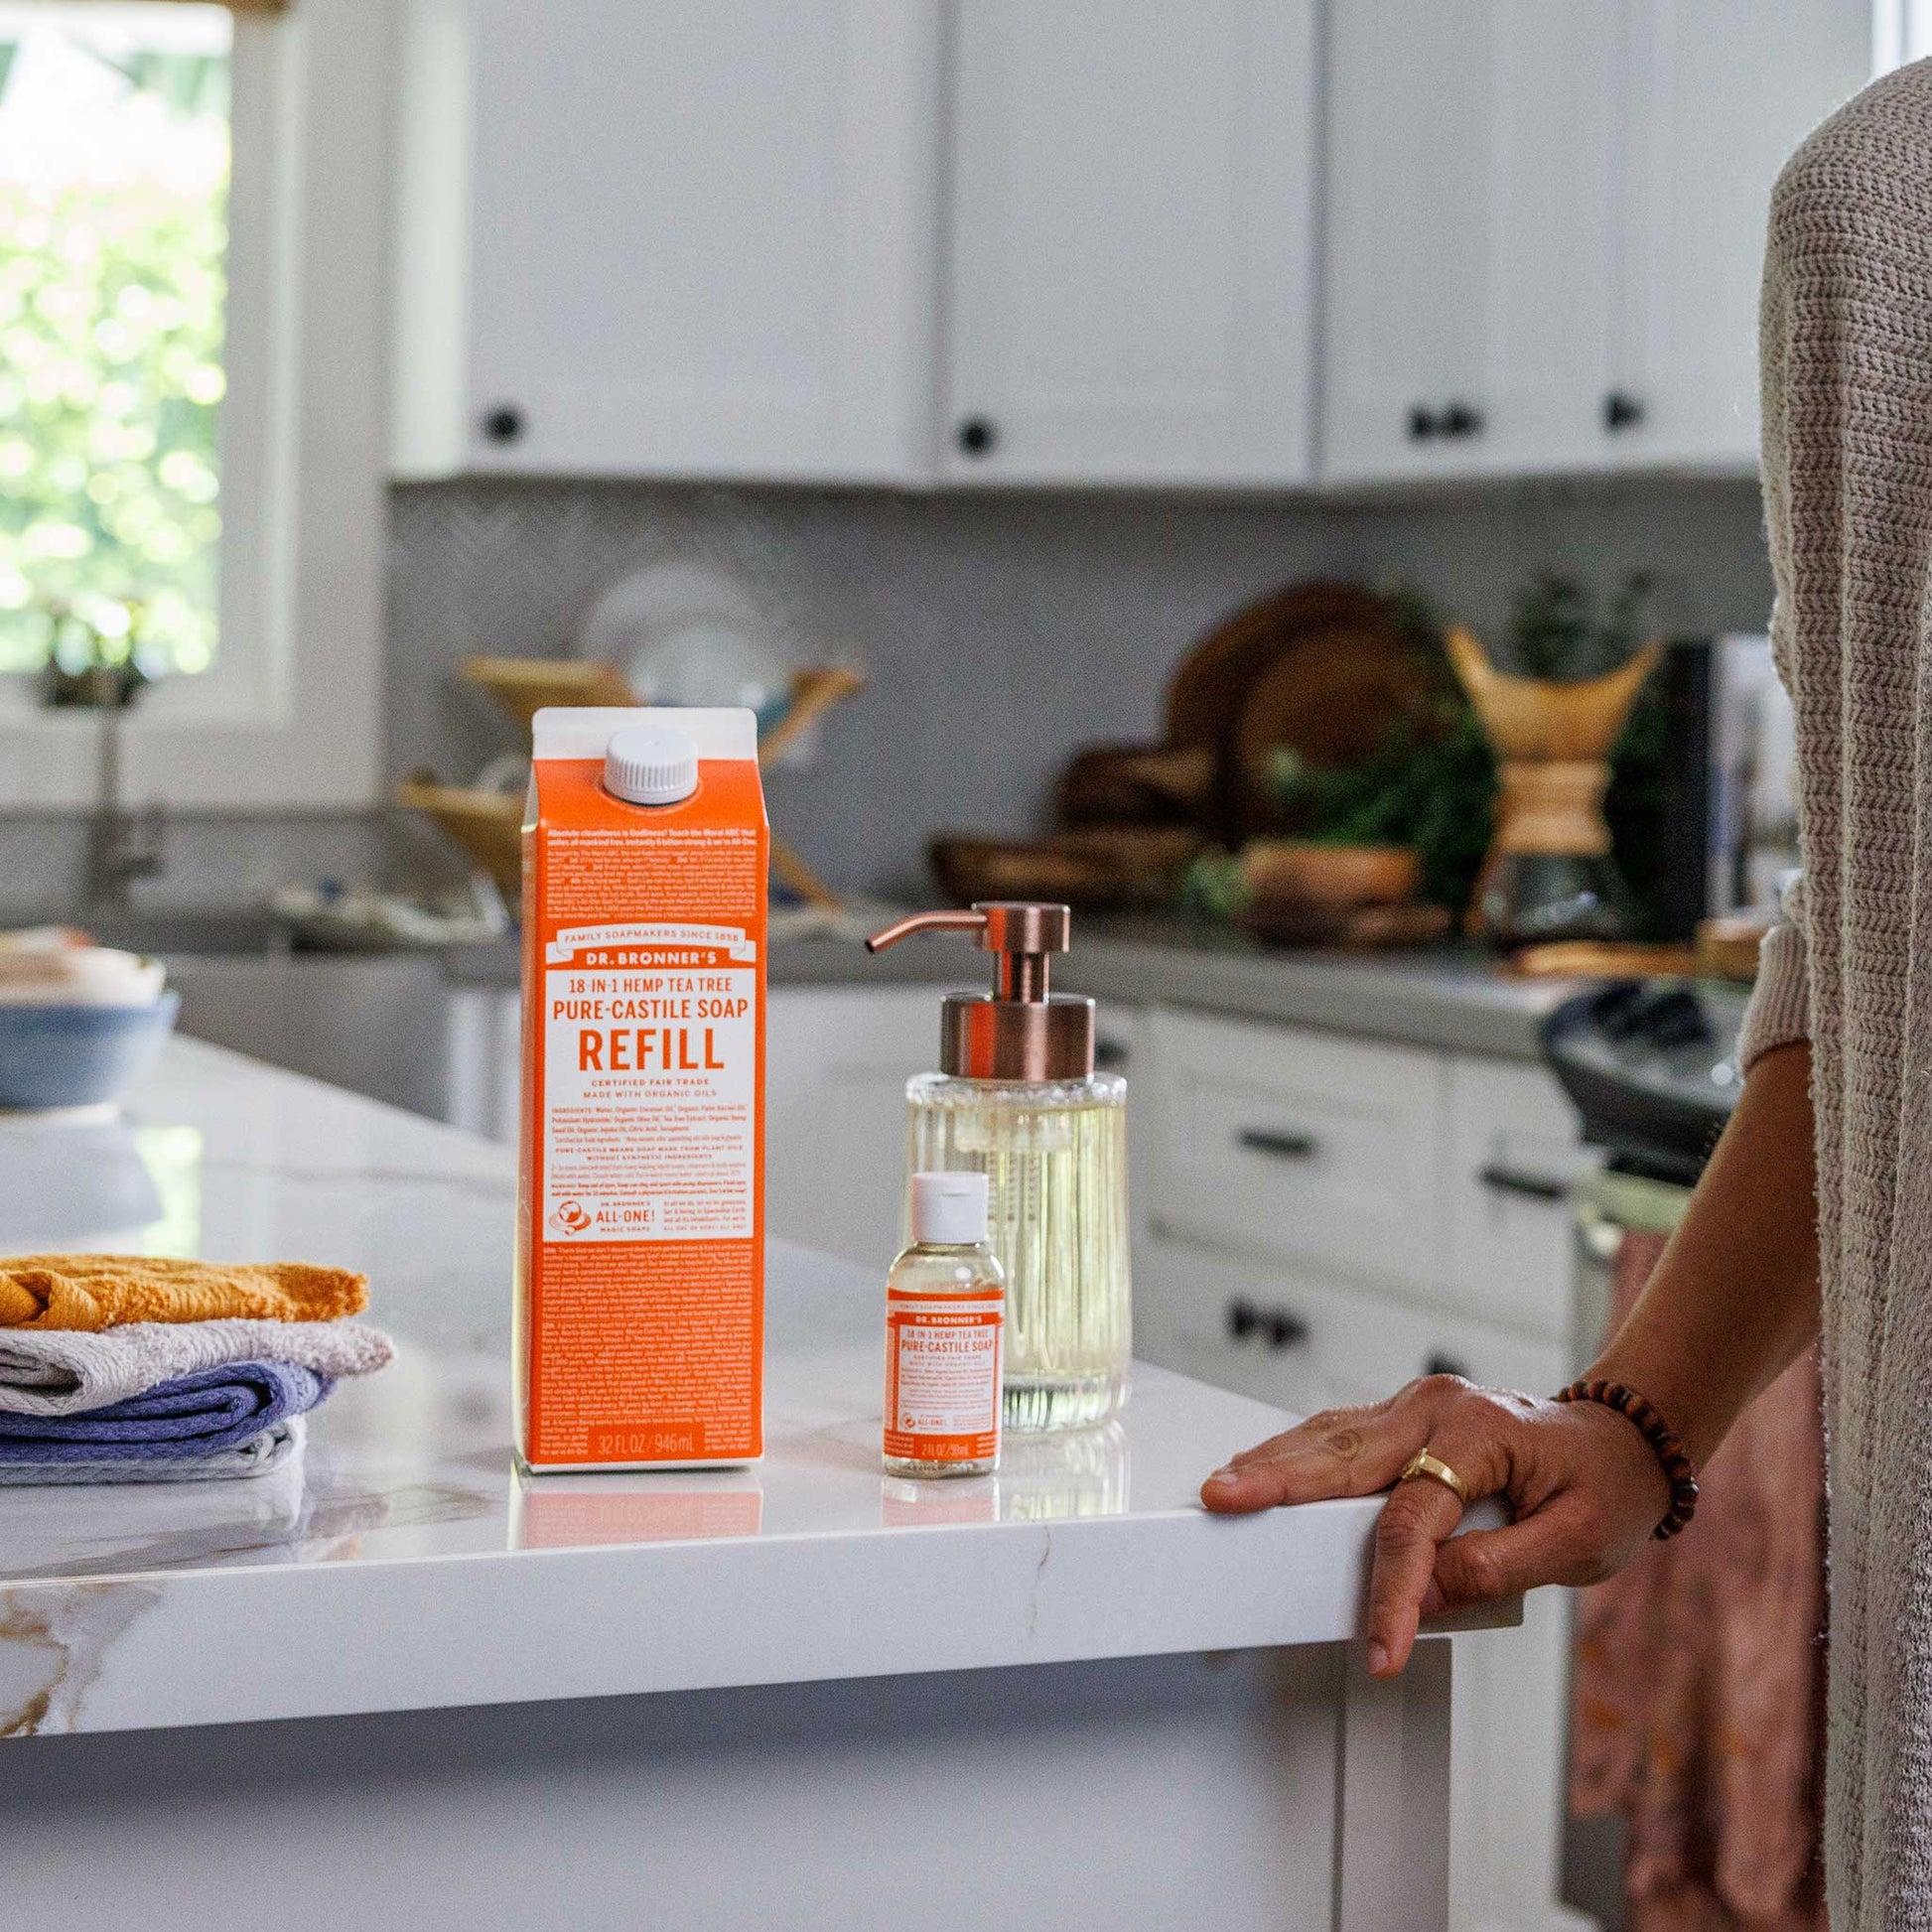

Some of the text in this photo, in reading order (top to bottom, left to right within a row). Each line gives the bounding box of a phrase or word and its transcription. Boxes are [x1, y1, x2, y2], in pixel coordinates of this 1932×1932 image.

[564, 931, 602, 943] FAMILY
[606, 928, 677, 939] SOAPMAKERS
[680, 928, 711, 940] SINCE
[586, 951, 717, 966] DR. BRONNER'S
[623, 978, 663, 993] HEMP
[667, 977, 693, 993] TEA
[697, 977, 733, 992] TREE
[553, 999, 749, 1021] PURE-CASTILE SOAP
[579, 1028, 725, 1070] REFILL
[596, 1209, 655, 1223] ALL-ONE!
[598, 1434, 614, 1455] 32
[616, 1434, 627, 1455] FL
